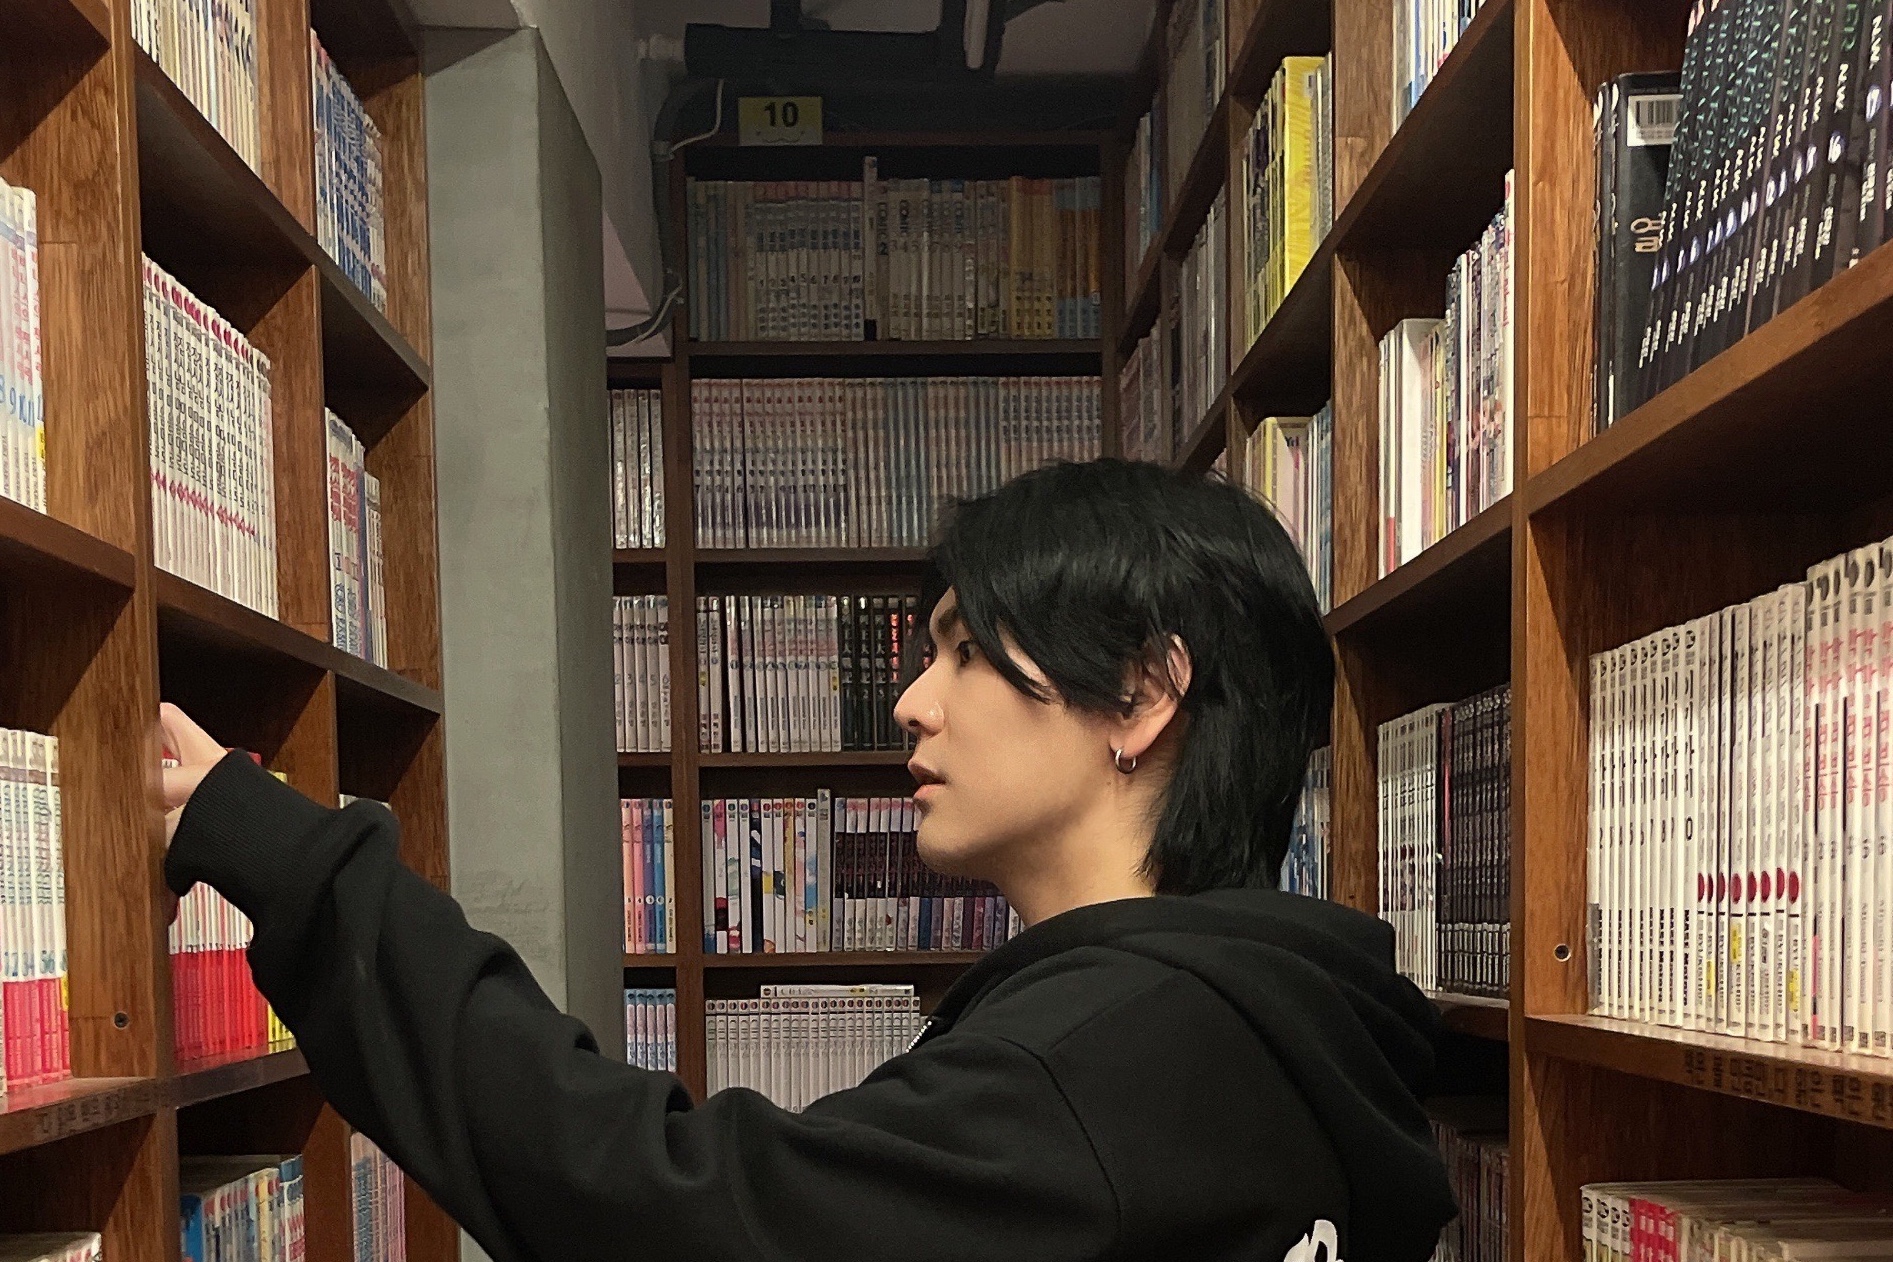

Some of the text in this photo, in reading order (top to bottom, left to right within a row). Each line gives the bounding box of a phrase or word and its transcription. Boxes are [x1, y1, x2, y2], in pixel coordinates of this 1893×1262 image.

[1869, 15, 1883, 70] N.W.
[1834, 63, 1849, 113] N.W.
[764, 101, 798, 127] 10
[10, 387, 16, 415] 9
